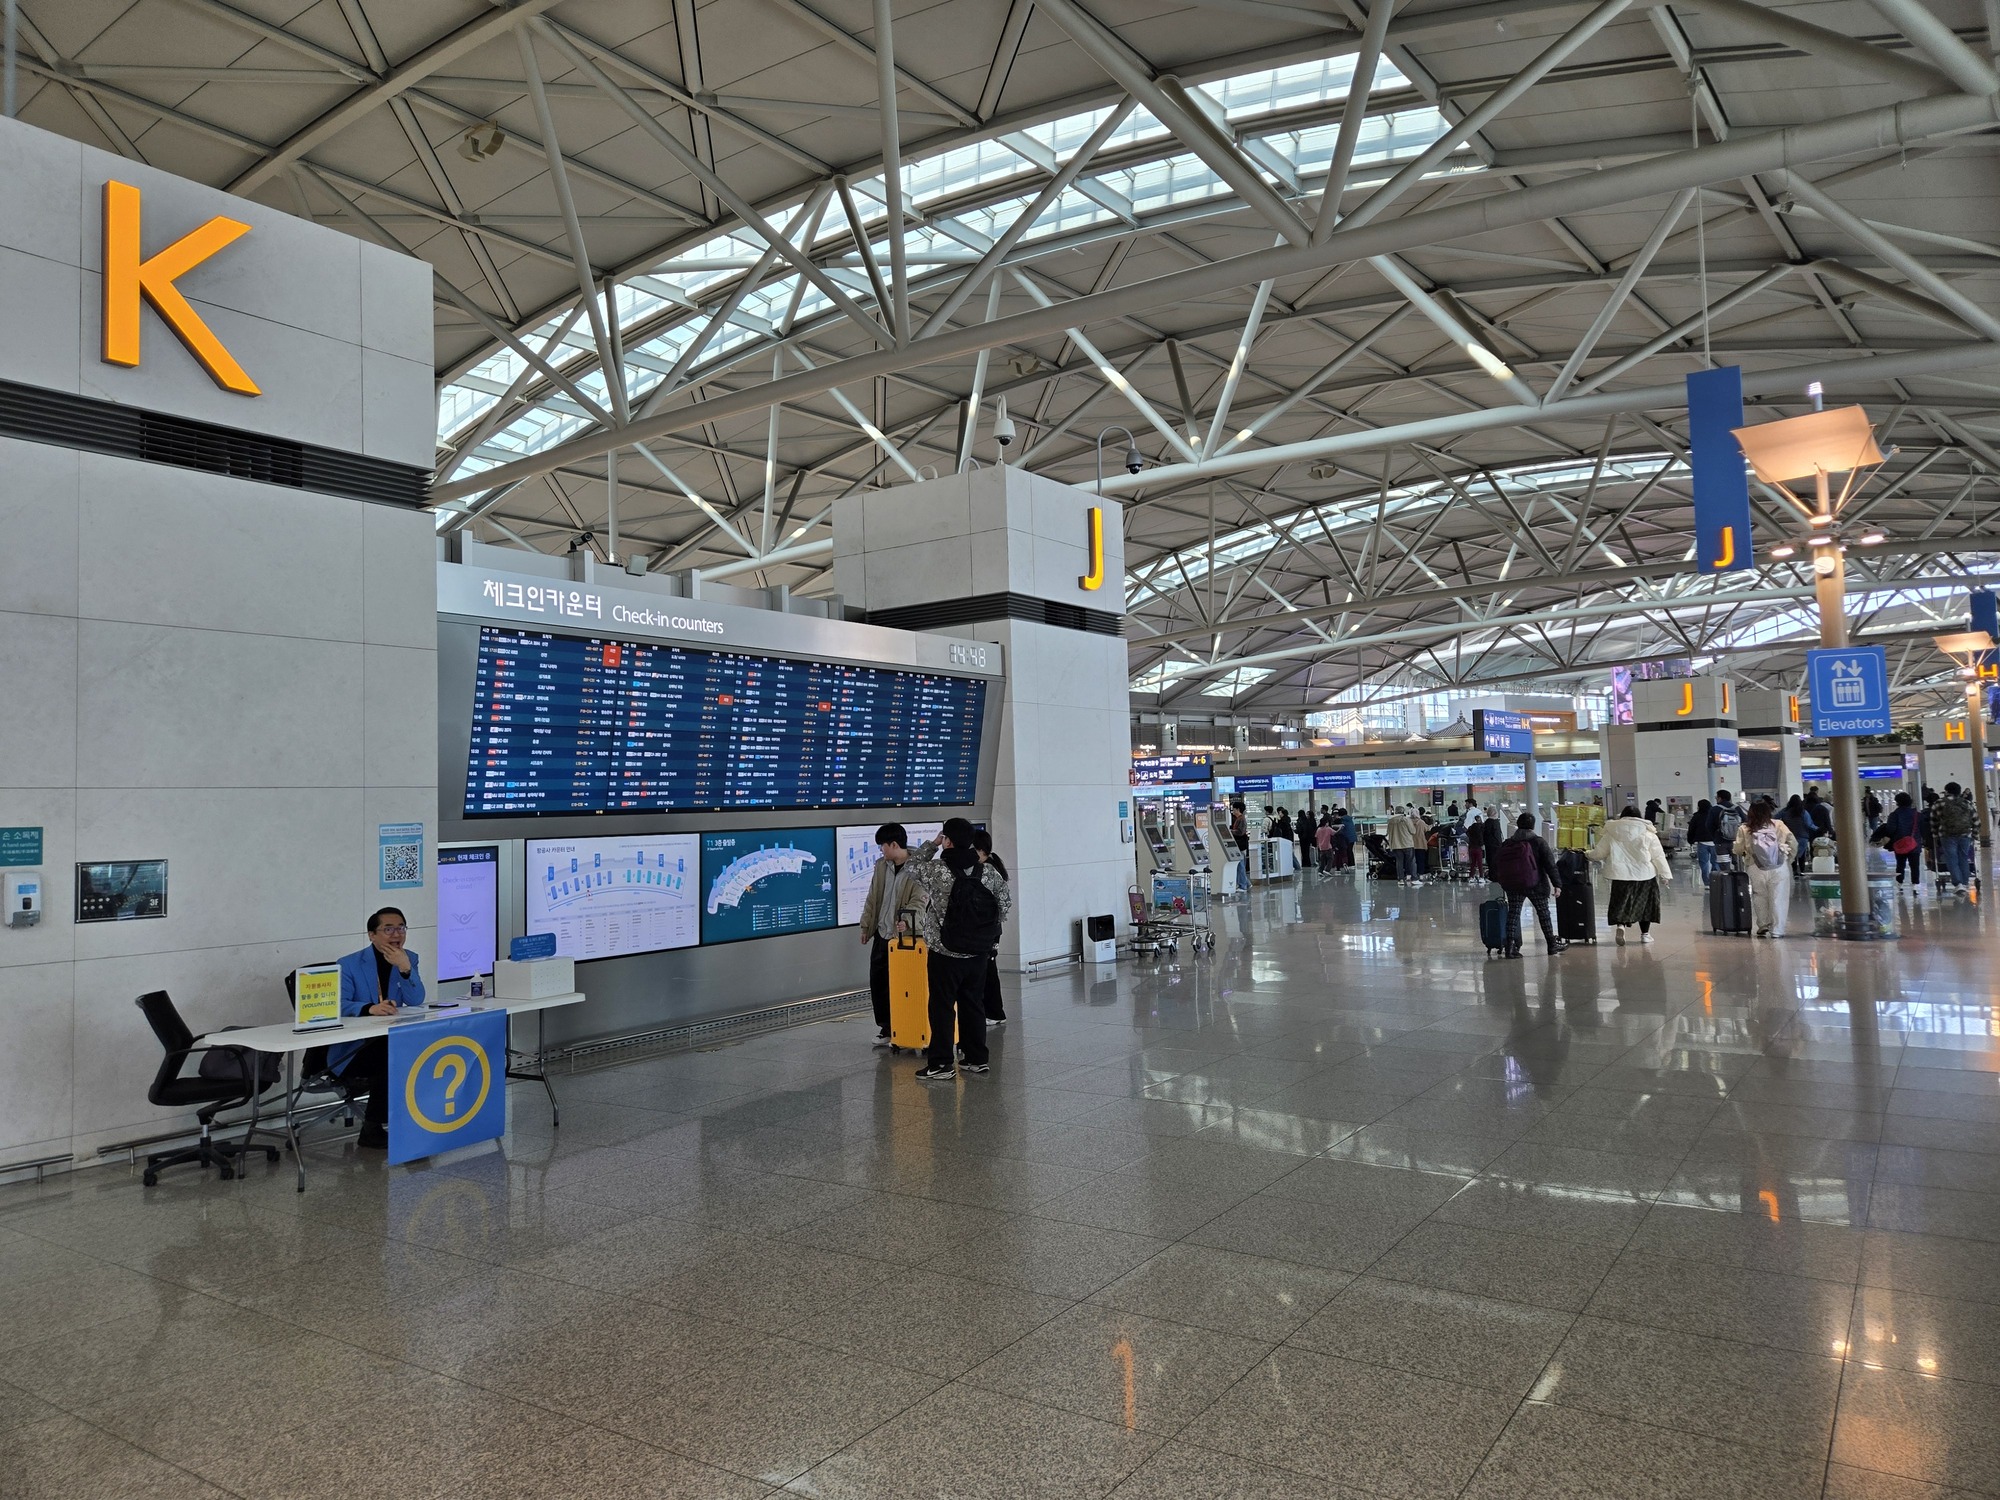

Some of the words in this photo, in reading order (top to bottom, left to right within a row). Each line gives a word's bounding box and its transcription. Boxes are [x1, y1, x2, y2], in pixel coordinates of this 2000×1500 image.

[100, 179, 262, 397] K
[1078, 507, 1104, 591] J
[1713, 526, 1735, 568] J
[483, 579, 602, 619] 체크인카운터
[612, 604, 670, 628] Check-in
[671, 610, 724, 635] counters
[949, 644, 986, 668] 14:48
[1978, 663, 1998, 679] H
[1676, 683, 1694, 716] J
[1722, 683, 1729, 714] J
[1790, 695, 1799, 723] H
[1819, 716, 1885, 732] Elevators
[1945, 721, 1965, 741] H
[1193, 756, 1206, 765] 4-6
[2, 831, 11, 840] 손
[13, 831, 39, 840] 소독제
[150, 898, 159, 906] 3F
[302, 1000, 336, 1010] (VOLUNTEER)
